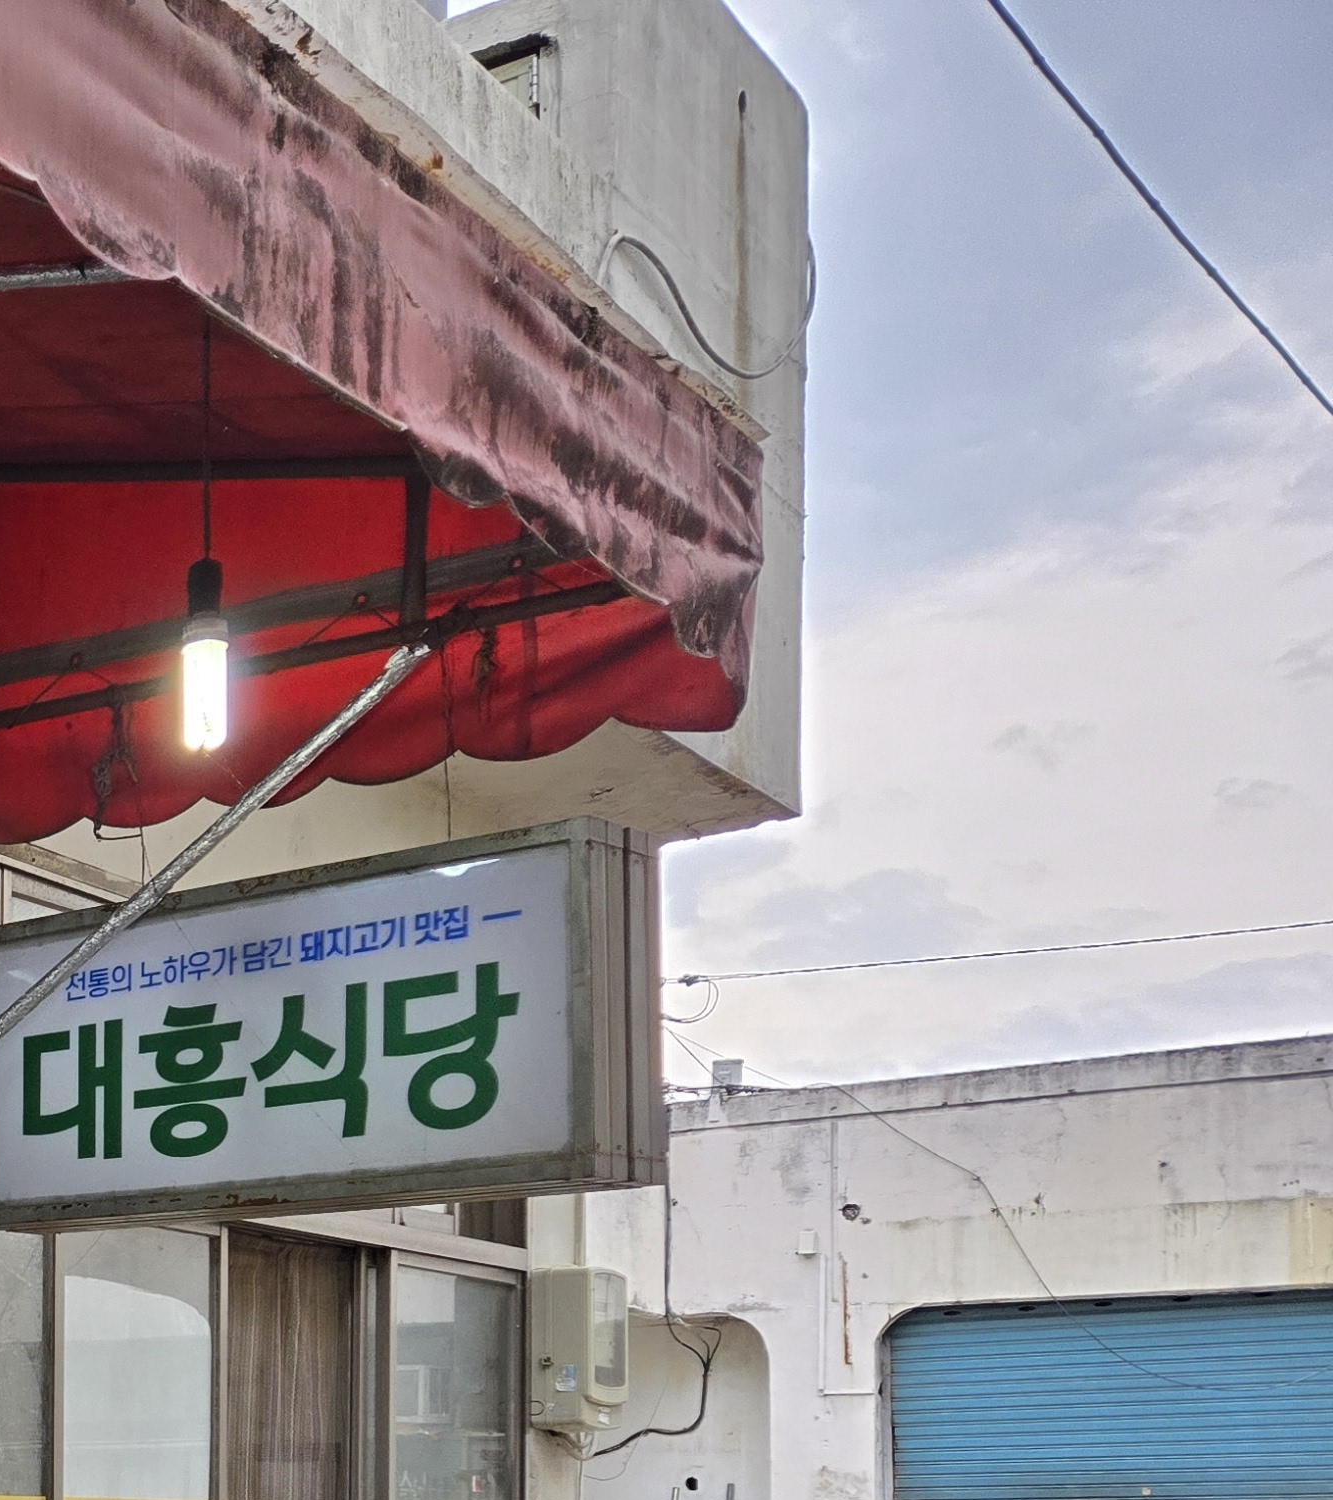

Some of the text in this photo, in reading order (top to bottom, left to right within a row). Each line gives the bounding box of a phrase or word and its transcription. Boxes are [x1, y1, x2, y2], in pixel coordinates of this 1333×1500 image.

[65, 905, 469, 1002] 전통의 노하우가 담긴 돼지고기 맛집
[22, 961, 521, 1161] 대흥식당
